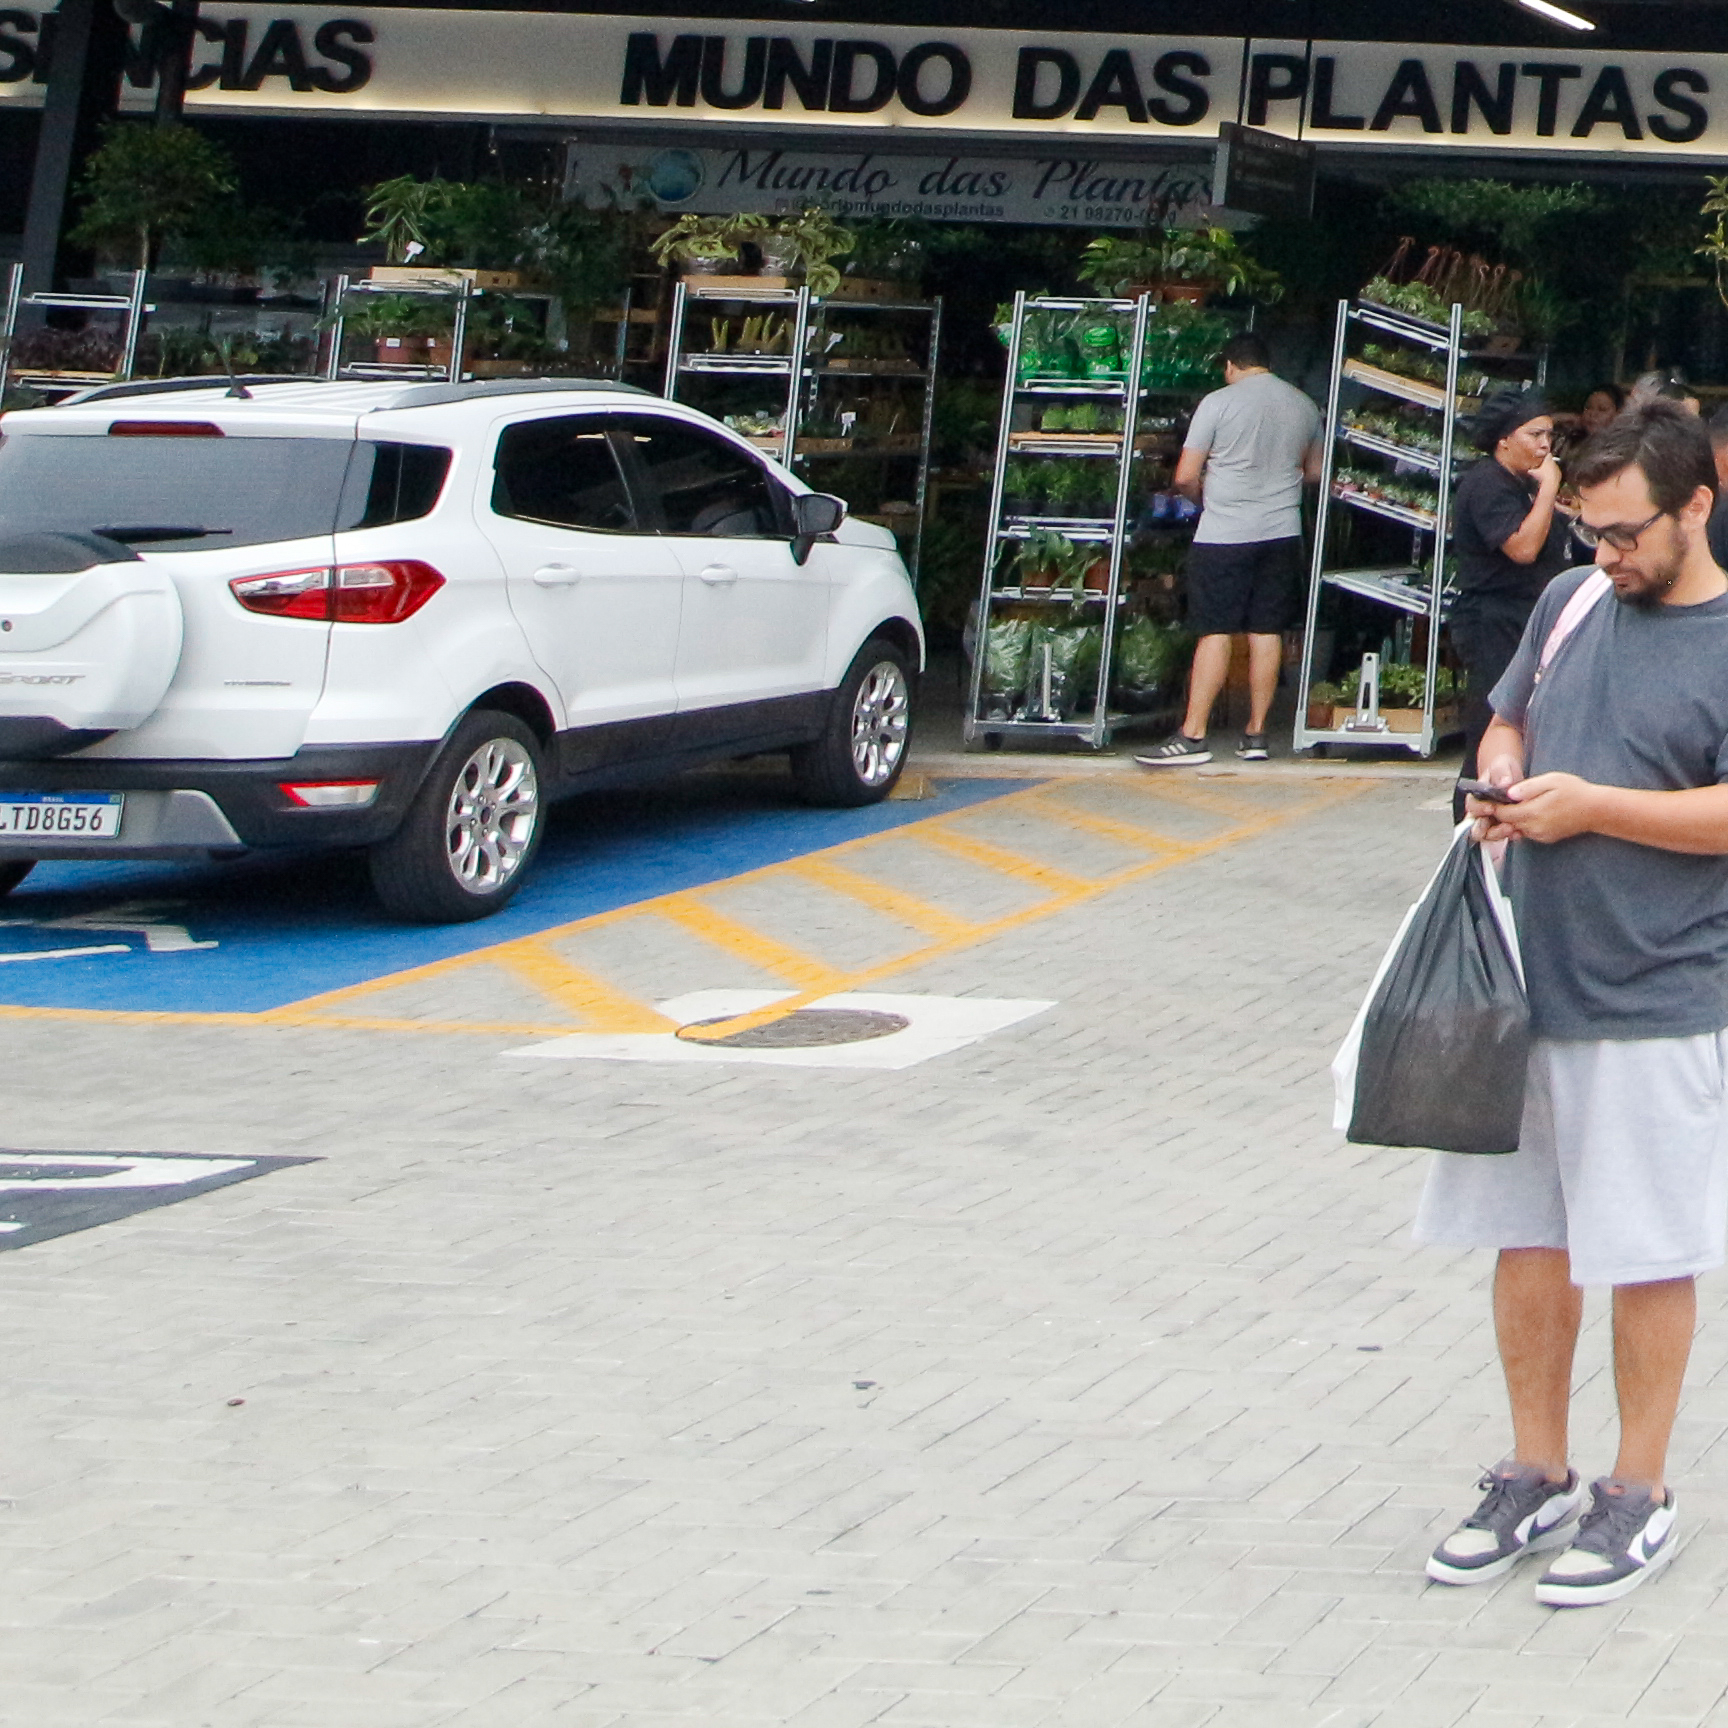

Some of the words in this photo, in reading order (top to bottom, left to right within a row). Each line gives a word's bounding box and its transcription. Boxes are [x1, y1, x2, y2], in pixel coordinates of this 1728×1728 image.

[620, 32, 972, 118] MUNDO
[1012, 46, 1211, 127] DAS
[1247, 52, 1710, 145] PLANTAS
[717, 148, 898, 196] Mundo
[918, 157, 1013, 197] das
